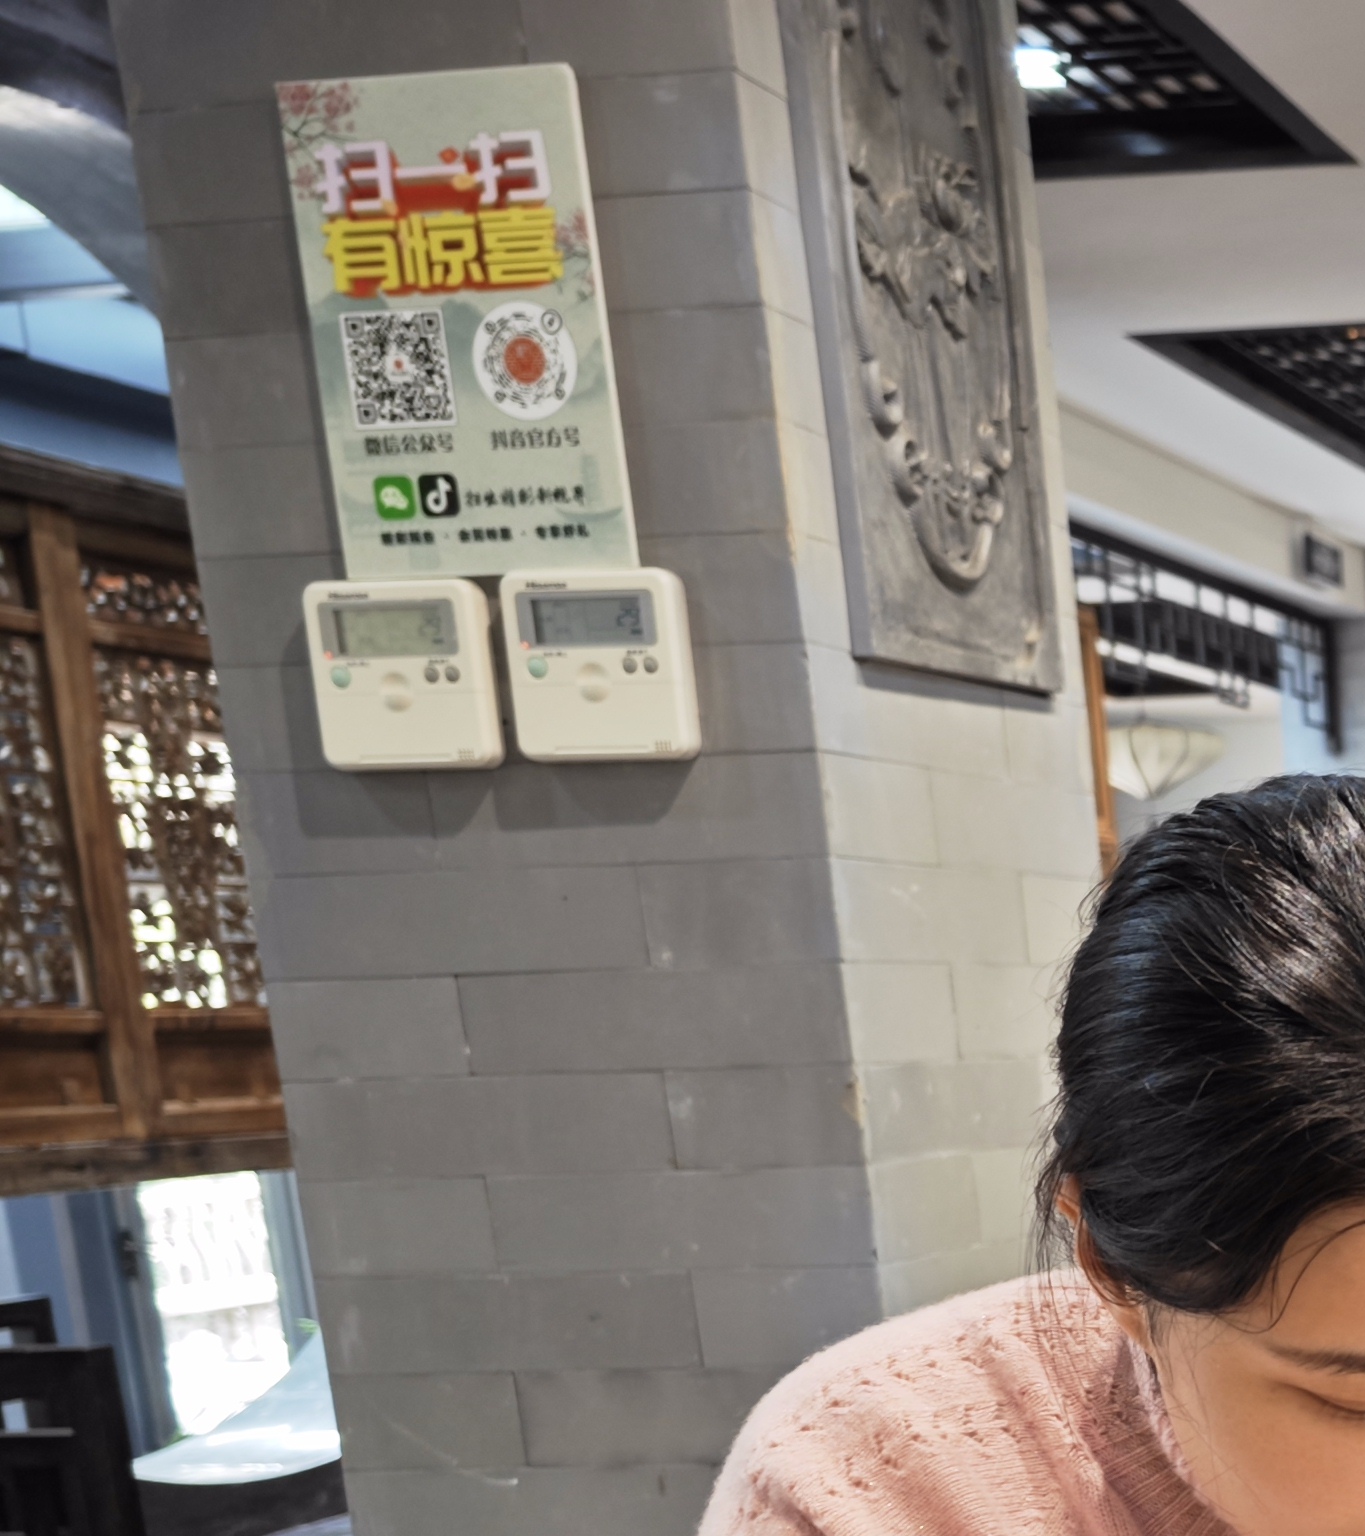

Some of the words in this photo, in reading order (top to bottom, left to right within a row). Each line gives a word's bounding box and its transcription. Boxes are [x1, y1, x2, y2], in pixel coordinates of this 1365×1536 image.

[315, 130, 553, 214] 扫一扫
[322, 207, 564, 292] 有惊喜
[364, 432, 454, 457] 微信公众号
[491, 427, 580, 451] 抖音官方号
